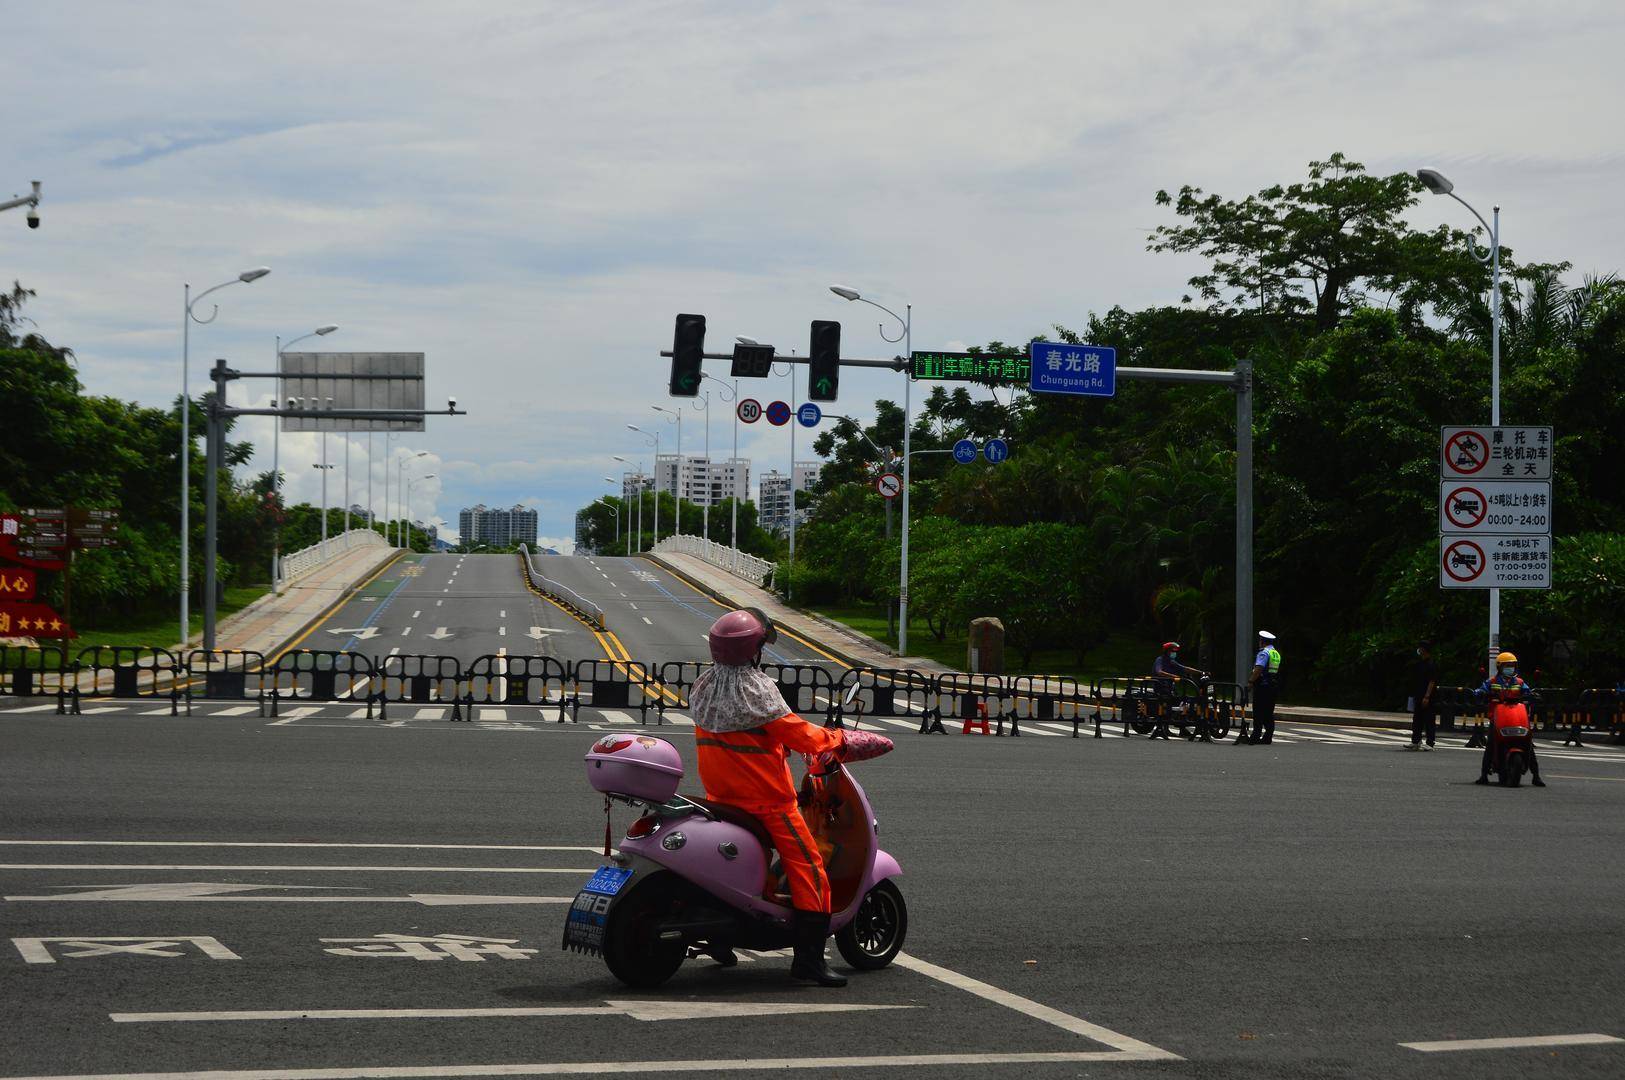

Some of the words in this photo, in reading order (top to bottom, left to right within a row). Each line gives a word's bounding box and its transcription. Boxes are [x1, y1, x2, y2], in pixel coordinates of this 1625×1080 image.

[1046, 350, 1100, 373] 春光路
[1041, 375, 1090, 388] Chunguang
[1091, 378, 1105, 387] Rd.
[743, 404, 757, 417] 50
[1493, 429, 1548, 444] 摩托车
[1492, 446, 1548, 460] 三轮机动车
[1502, 462, 1536, 475] 全天
[1498, 539, 1539, 548] 4.5吨以下
[1492, 552, 1549, 561] 非新能源货车
[1497, 573, 1544, 581] 17:00-21:00
[573, 893, 612, 915] 新日
